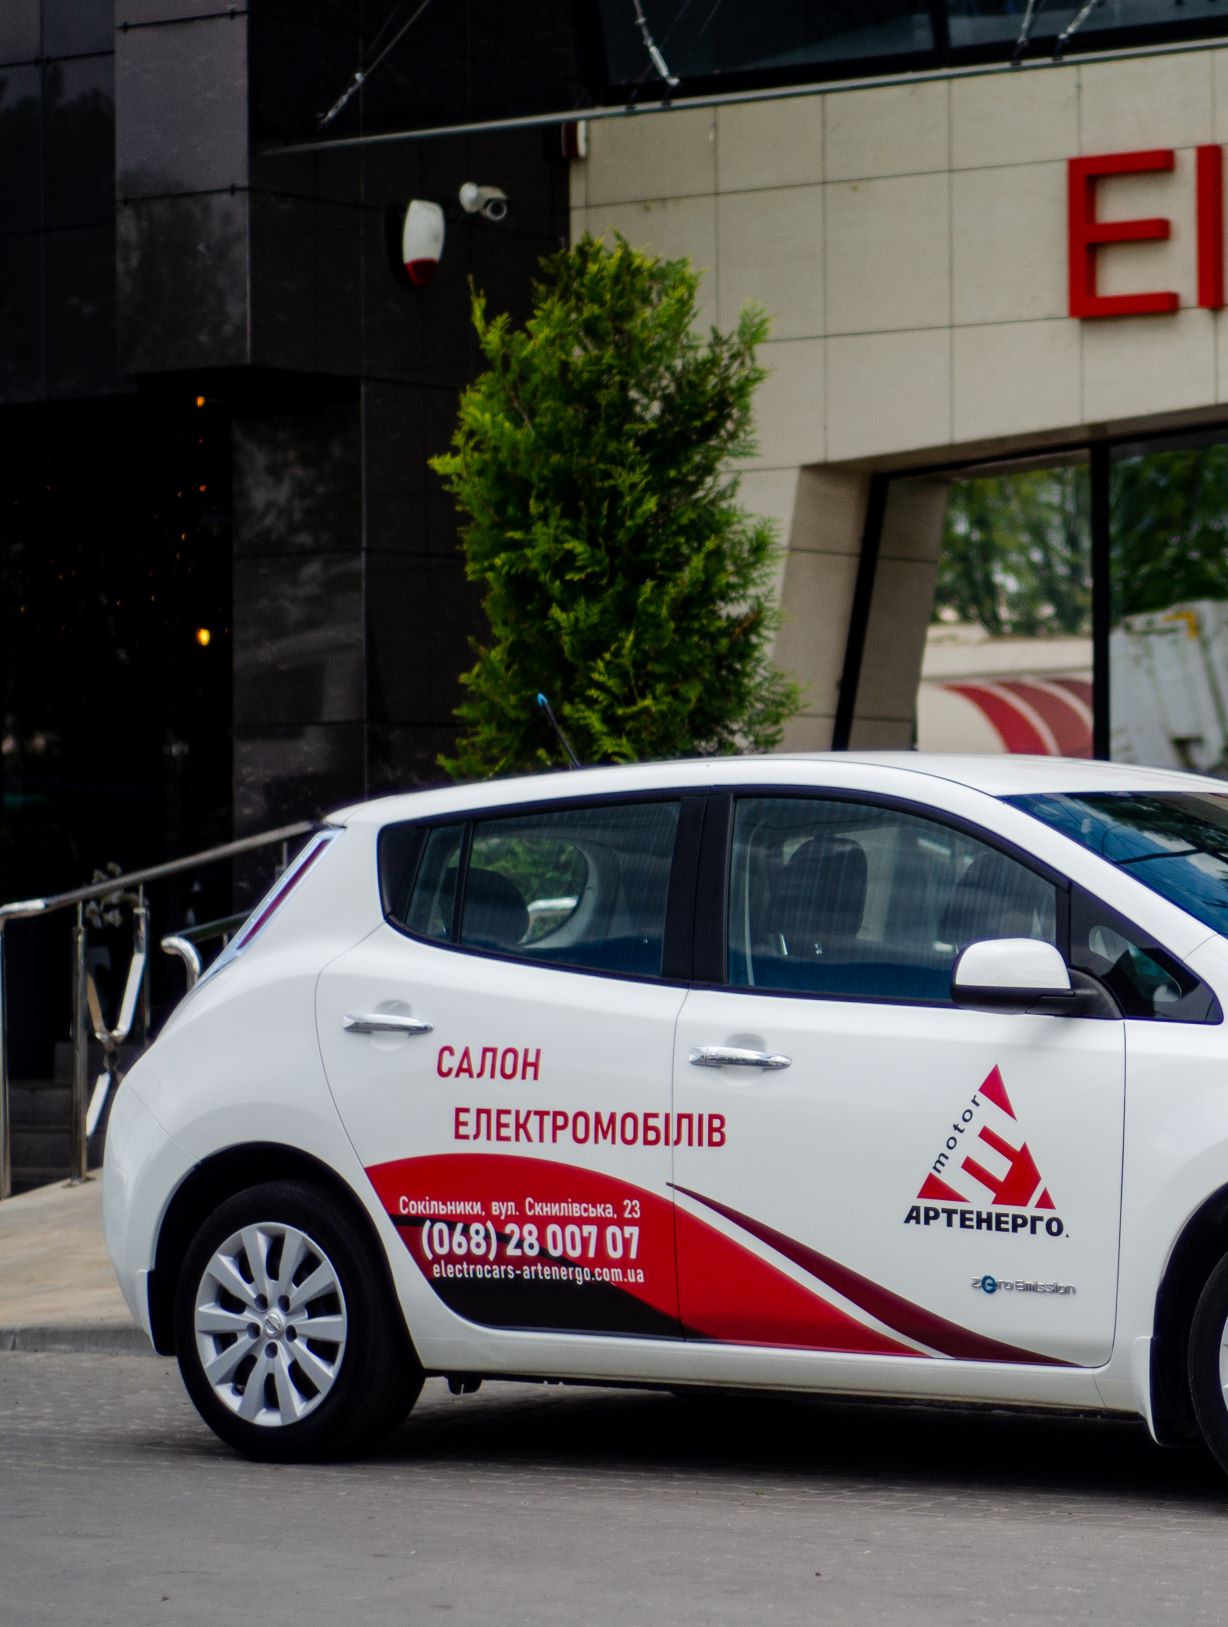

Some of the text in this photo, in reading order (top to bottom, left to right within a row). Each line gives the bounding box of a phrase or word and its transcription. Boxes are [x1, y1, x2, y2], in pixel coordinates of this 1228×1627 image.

[437, 1045, 541, 1081] САЛОН
[454, 1107, 727, 1147] ЕЛЕКТРОМОБІЛІВ
[932, 1094, 981, 1174] motor
[400, 1196, 641, 1219] Сокільники, вул. Скнилівська, 23
[904, 1205, 1064, 1237] АРТЕНЕРГО
[422, 1220, 640, 1261] (068) 28 007 07
[433, 1260, 644, 1285] electrocars-artenergo.com.ua
